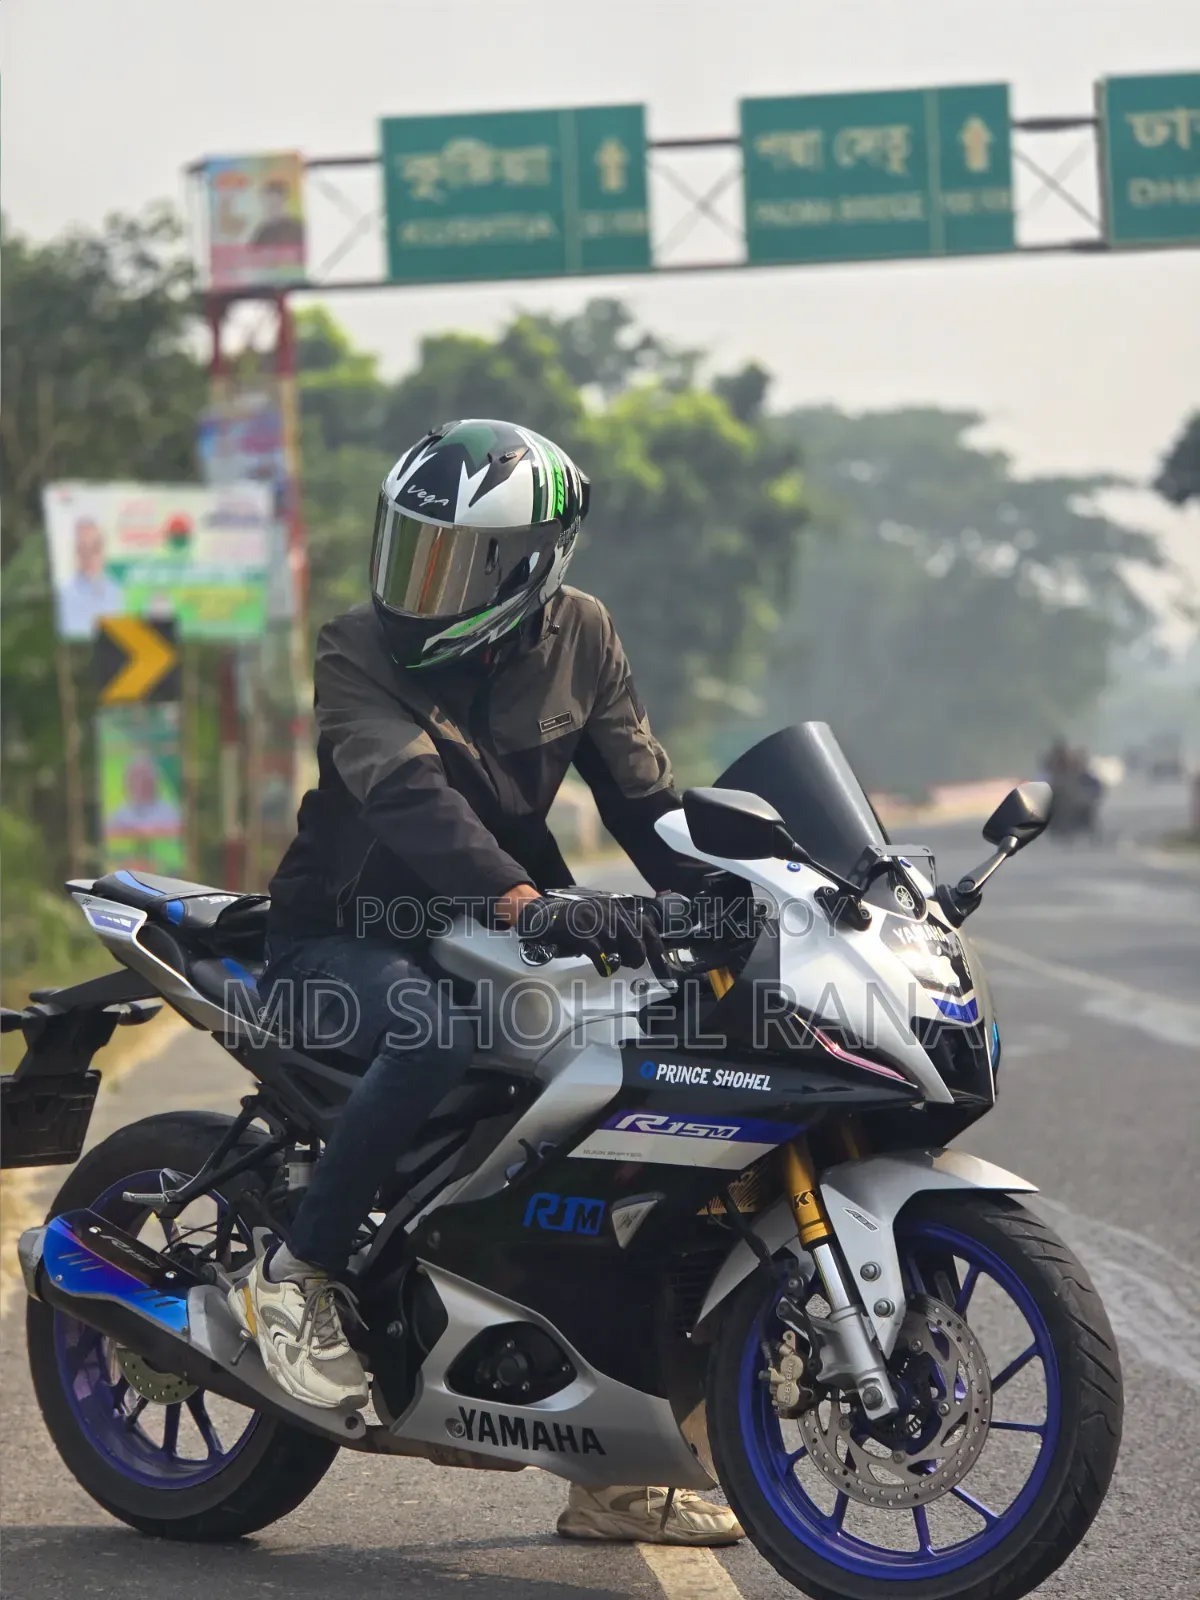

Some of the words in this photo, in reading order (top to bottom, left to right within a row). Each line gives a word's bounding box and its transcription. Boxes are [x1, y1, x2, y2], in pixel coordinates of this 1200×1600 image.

[892, 923, 951, 945] YAMAHA
[656, 1063, 711, 1085] PRINCE
[712, 1069, 772, 1091] SHOHEL
[615, 1113, 741, 1139] R15M
[523, 1192, 606, 1235] R1M
[458, 1406, 607, 1456] YAMAHA
